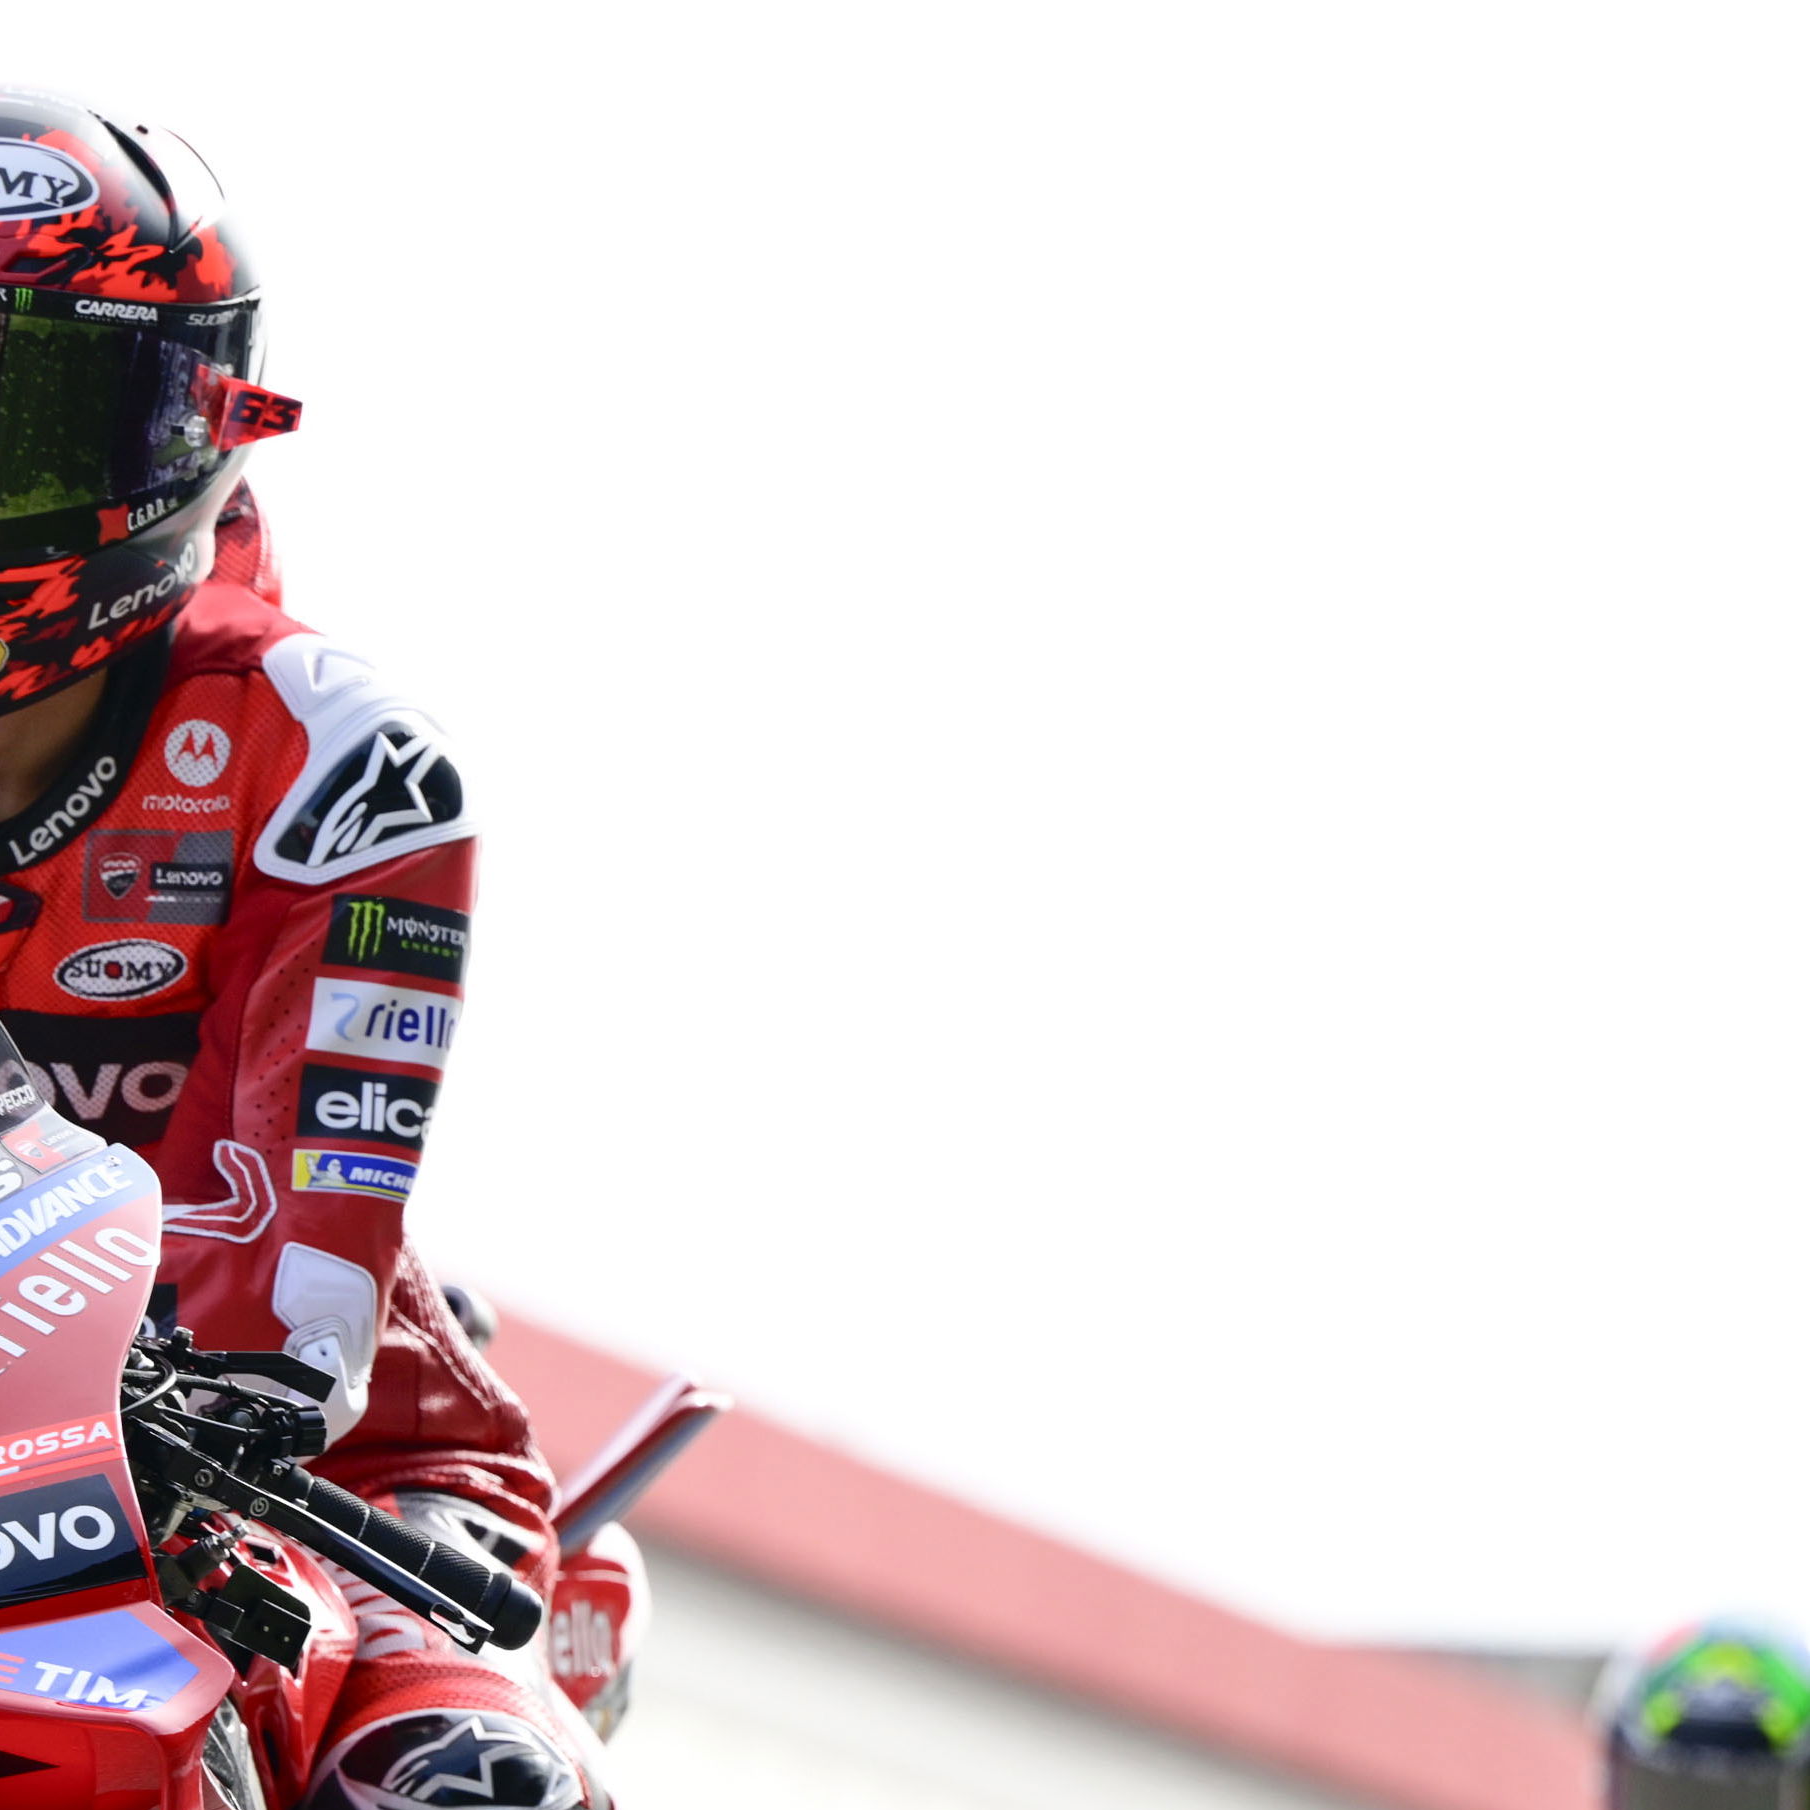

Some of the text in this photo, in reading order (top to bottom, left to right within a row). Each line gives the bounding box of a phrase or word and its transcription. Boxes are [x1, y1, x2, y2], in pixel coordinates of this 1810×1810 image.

[74, 299, 158, 322] CARRERA
[230, 390, 302, 433] 63
[87, 541, 196, 631] Lenovo
[8, 754, 118, 868] Lenovo
[155, 867, 224, 886] Lenovo
[386, 915, 468, 948] MONSTER
[69, 956, 175, 984] SUOMY
[34, 1661, 153, 1710] TIM
